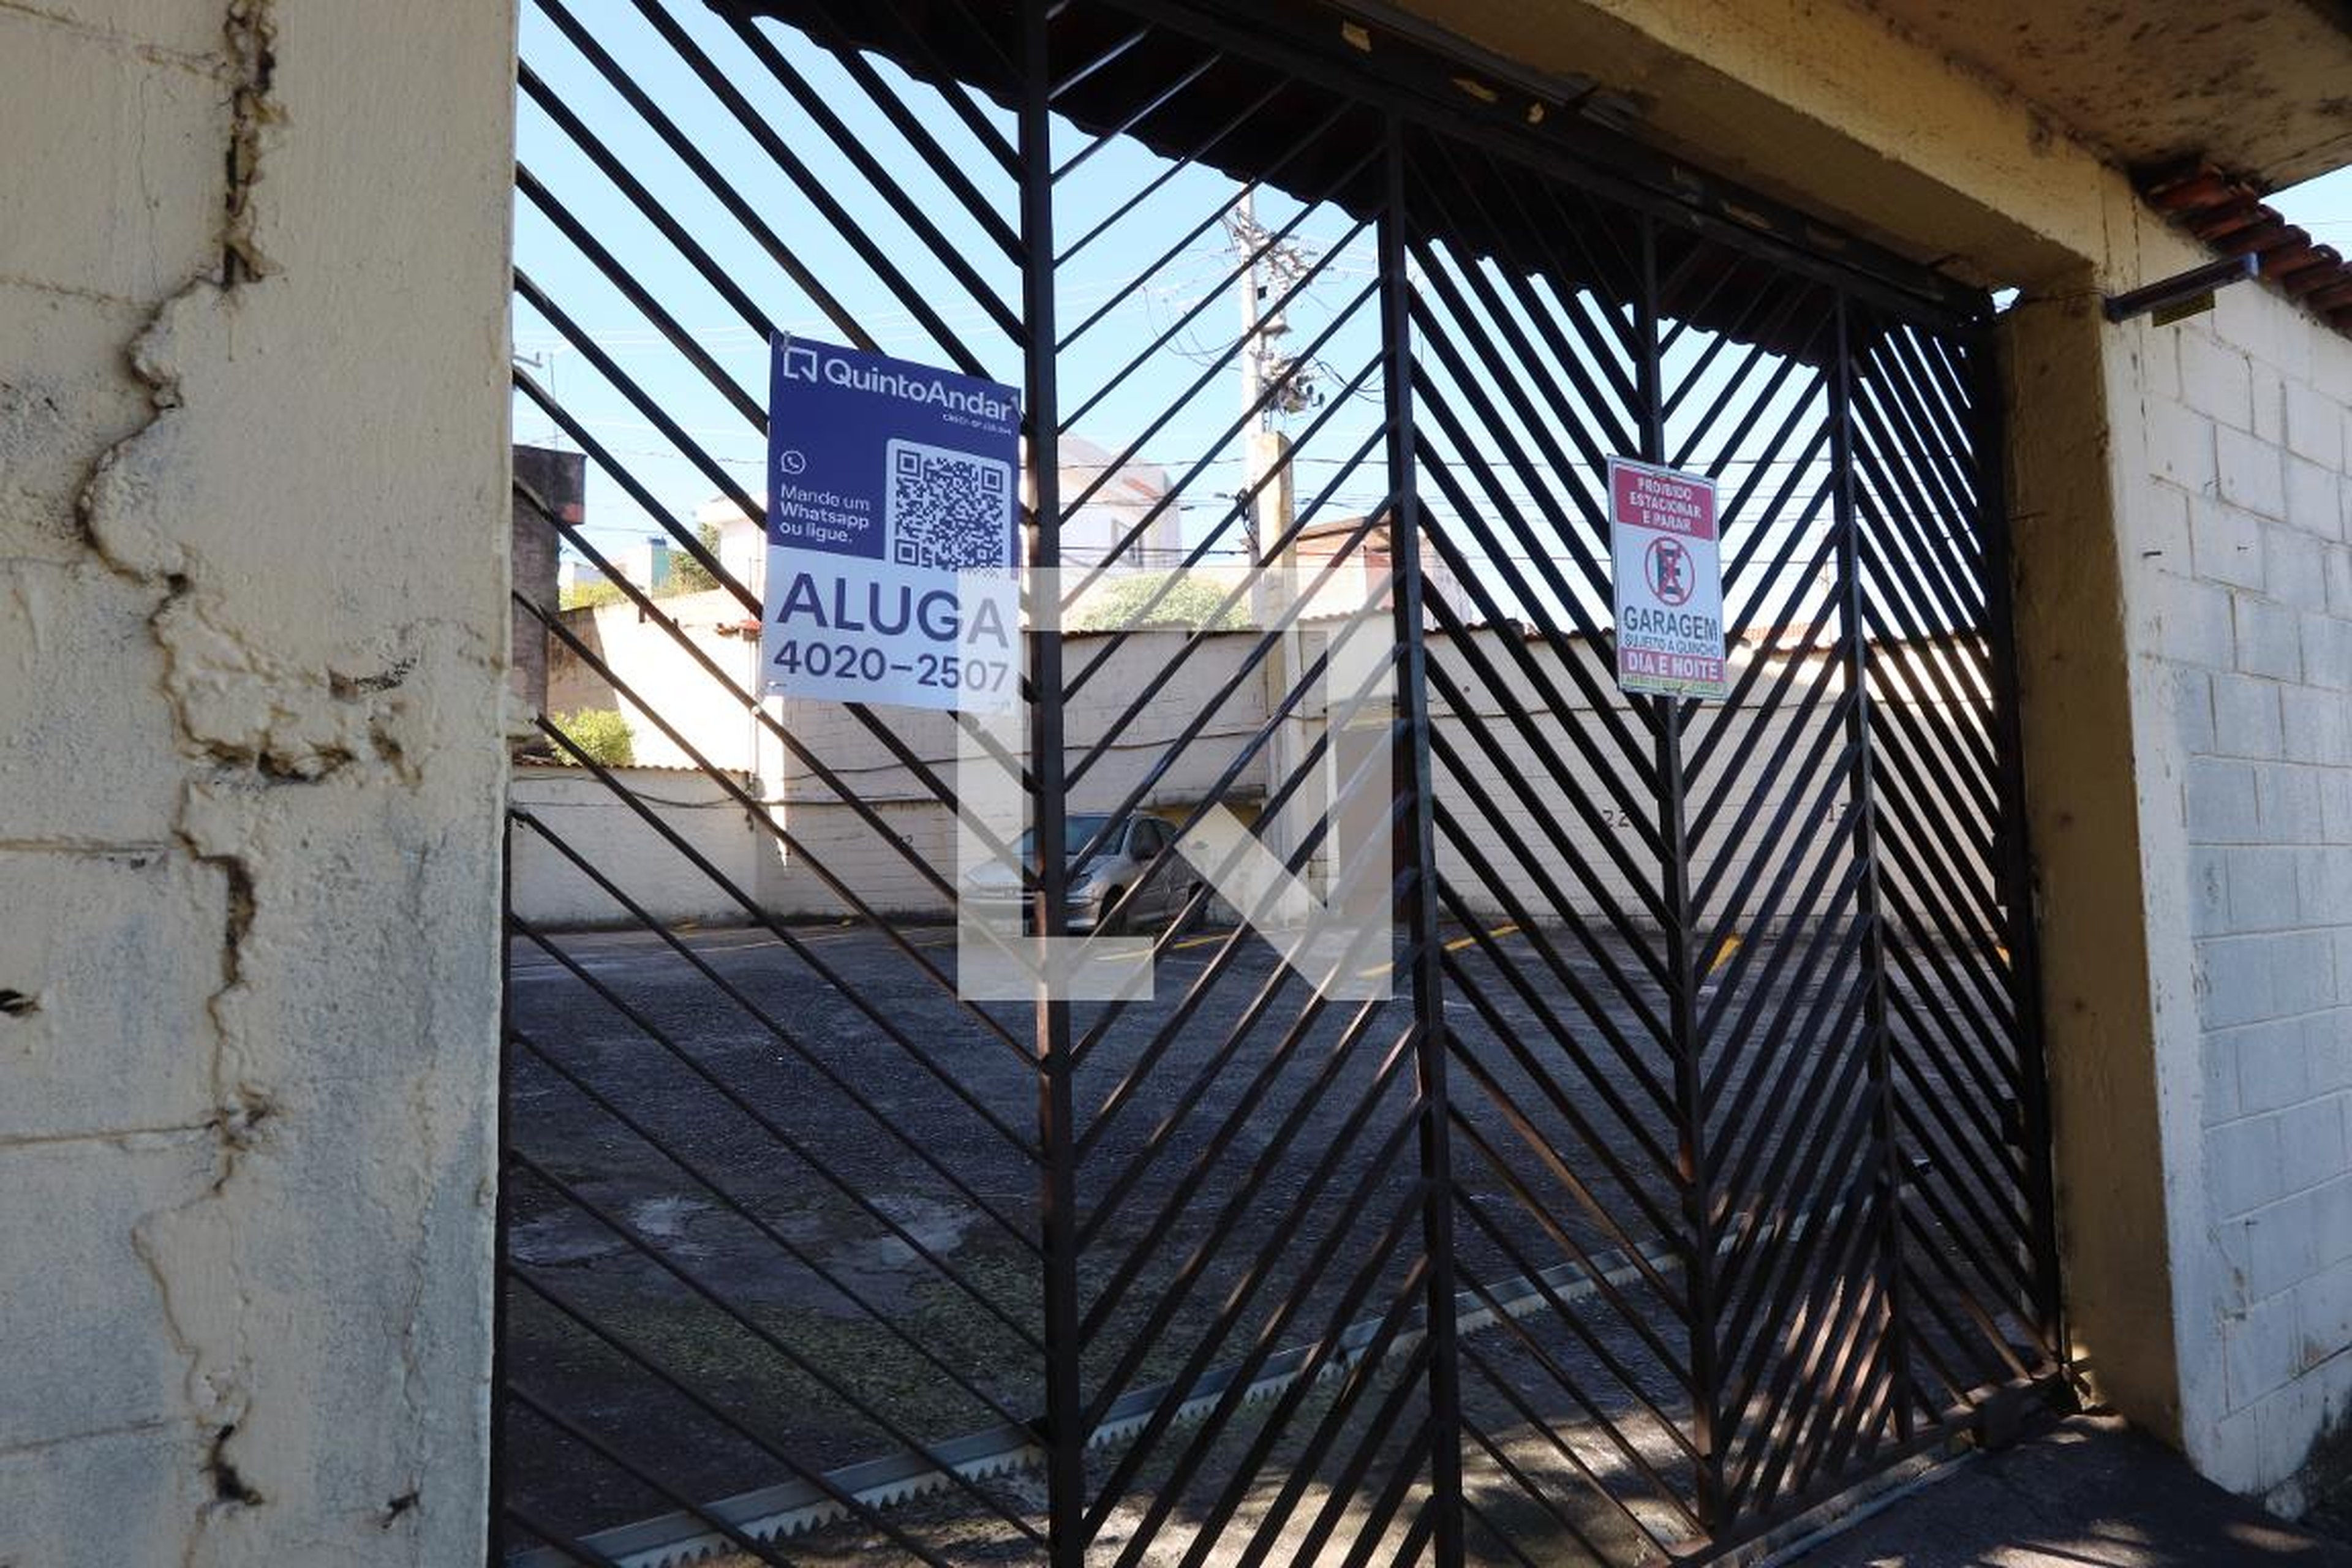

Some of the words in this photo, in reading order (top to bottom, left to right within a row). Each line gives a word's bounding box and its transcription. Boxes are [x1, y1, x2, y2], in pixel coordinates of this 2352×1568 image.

[824, 359, 1011, 421] QuintoAndar
[780, 501, 869, 530] Whatsapp
[843, 497, 870, 511] um
[1629, 491, 1702, 519] ESTACIONAR
[780, 522, 802, 535] ou
[806, 522, 853, 543] ligue.
[1642, 510, 1651, 524] E
[1653, 512, 1692, 532] PARAR
[776, 572, 1009, 649] ALUGA
[1624, 605, 1717, 641] GARAGEM
[1668, 640, 1675, 652] A
[774, 640, 1008, 692] 4020-2507
[1627, 651, 1654, 674] DIA
[1659, 655, 1668, 674] E
[1672, 657, 1719, 680] NOITE
